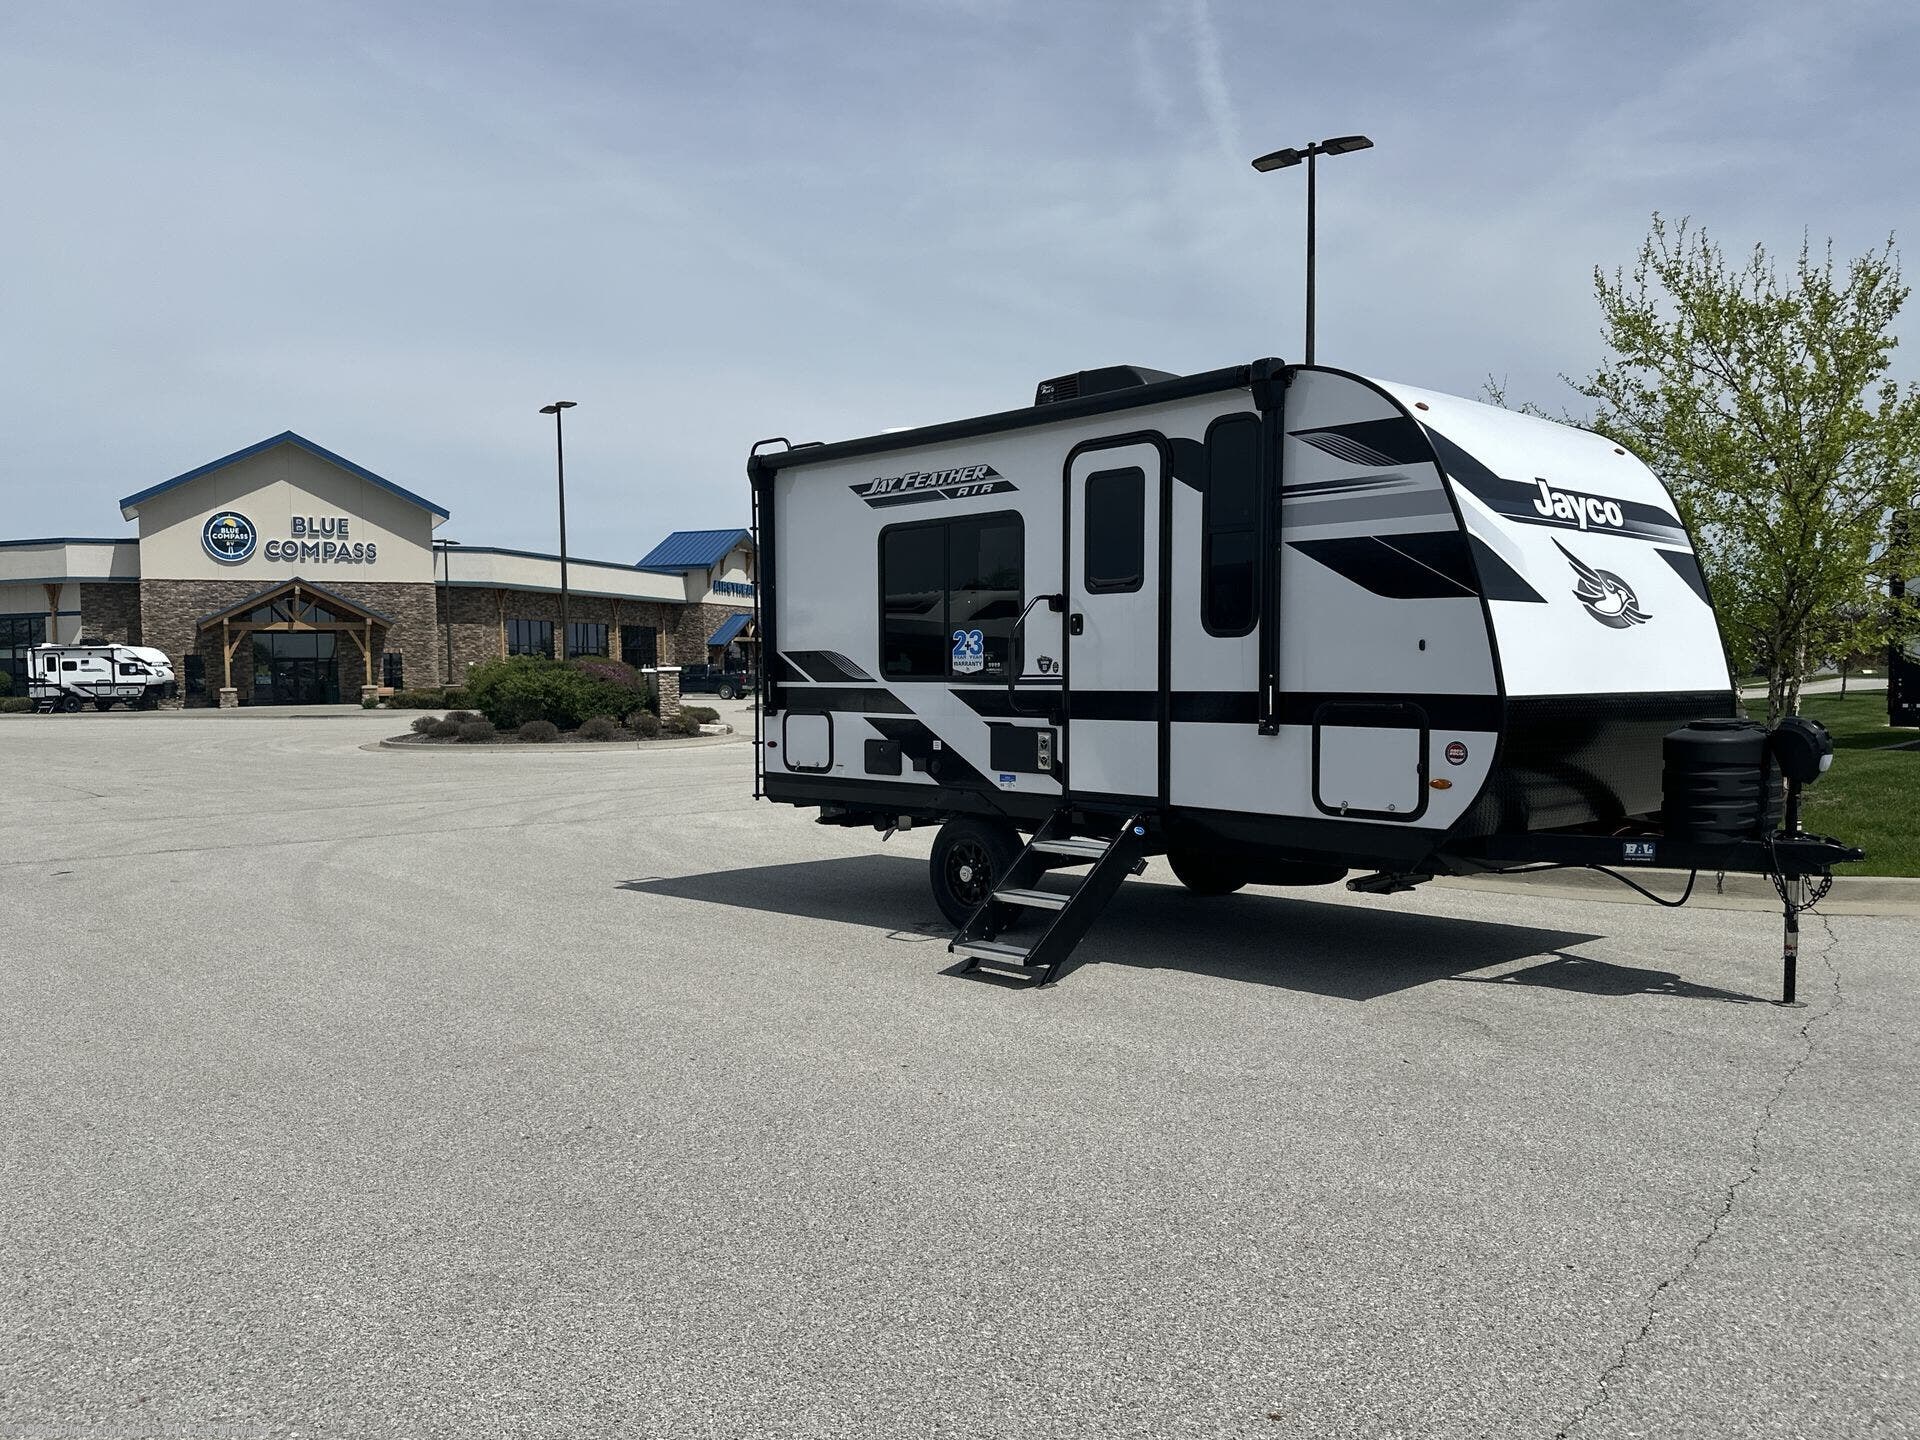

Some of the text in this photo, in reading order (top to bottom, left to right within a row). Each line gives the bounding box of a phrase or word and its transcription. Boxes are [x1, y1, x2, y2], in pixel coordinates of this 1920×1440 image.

[861, 465, 989, 496] JAY FEATHER
[956, 483, 994, 497] AIR
[1533, 479, 1624, 530] Jayco
[292, 516, 349, 536] BLUE
[265, 540, 377, 561] COMPASS
